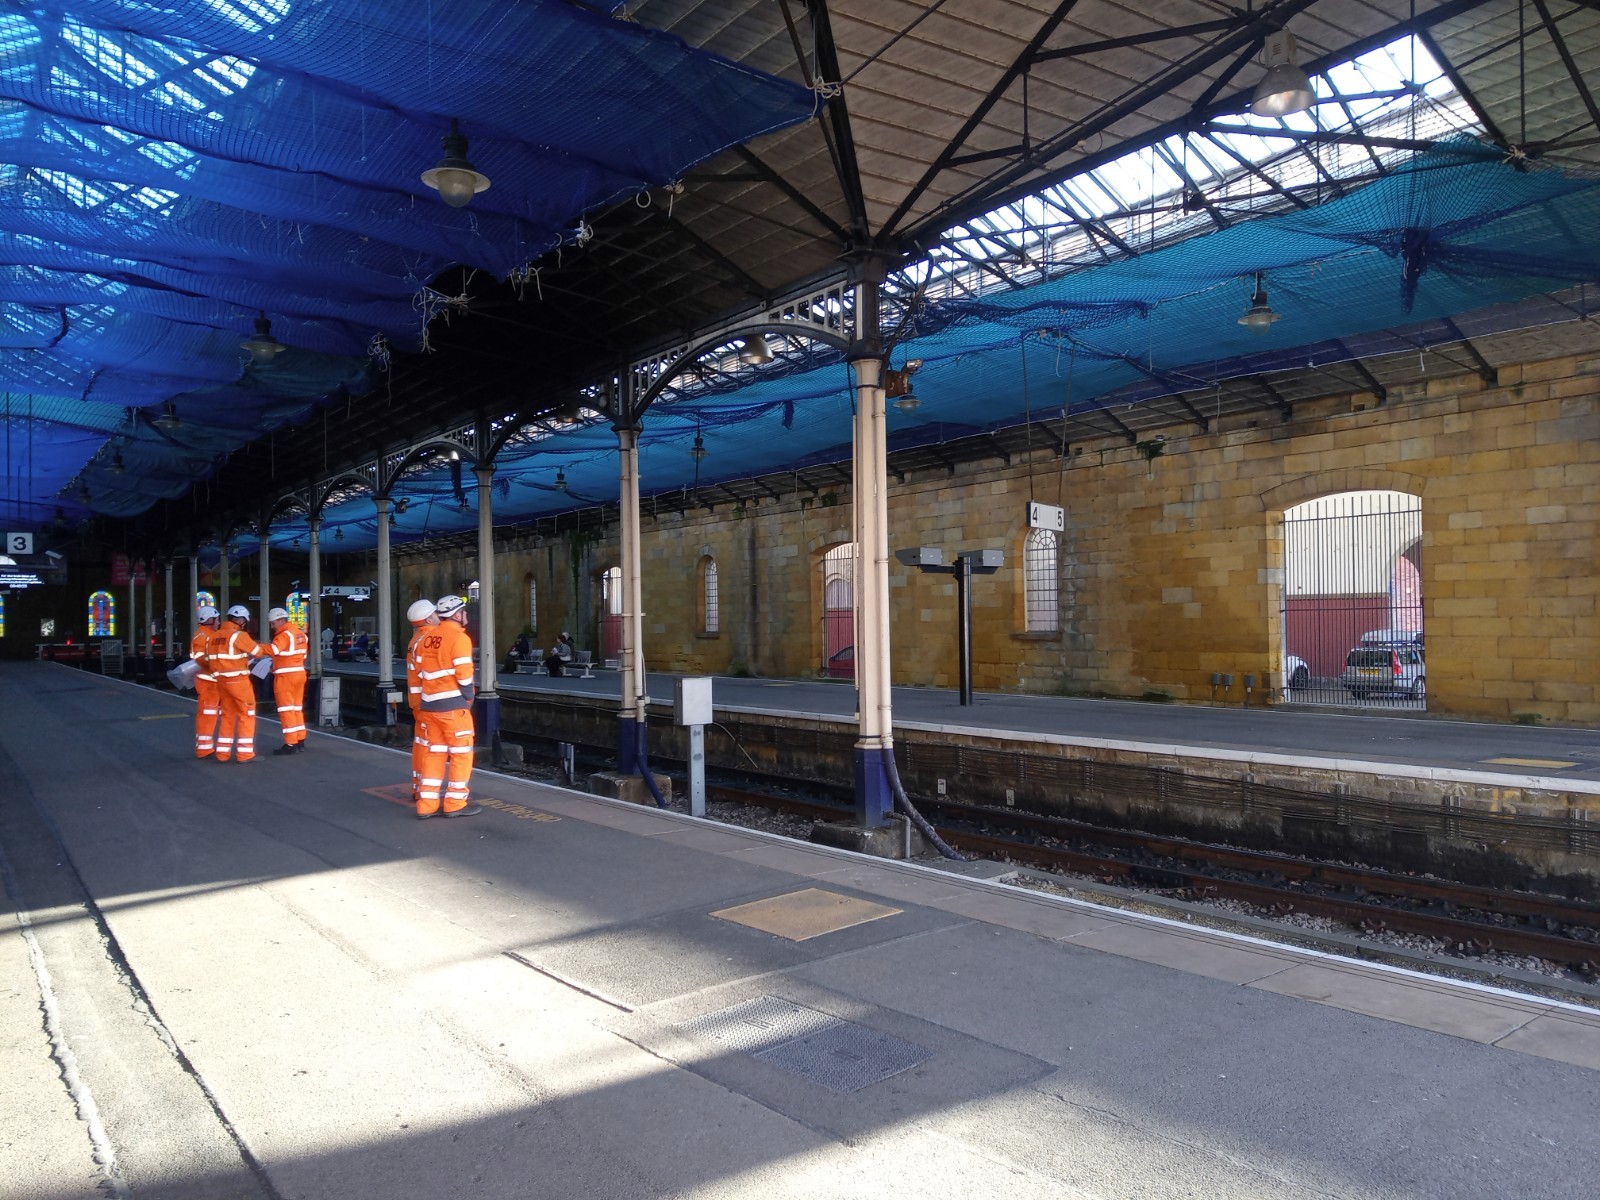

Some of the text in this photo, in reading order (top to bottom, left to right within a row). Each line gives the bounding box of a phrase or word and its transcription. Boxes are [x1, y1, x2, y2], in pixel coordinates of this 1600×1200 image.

[1032, 506, 1062, 527] 4 5
[13, 536, 26, 550] 3
[424, 636, 442, 649] ORB
